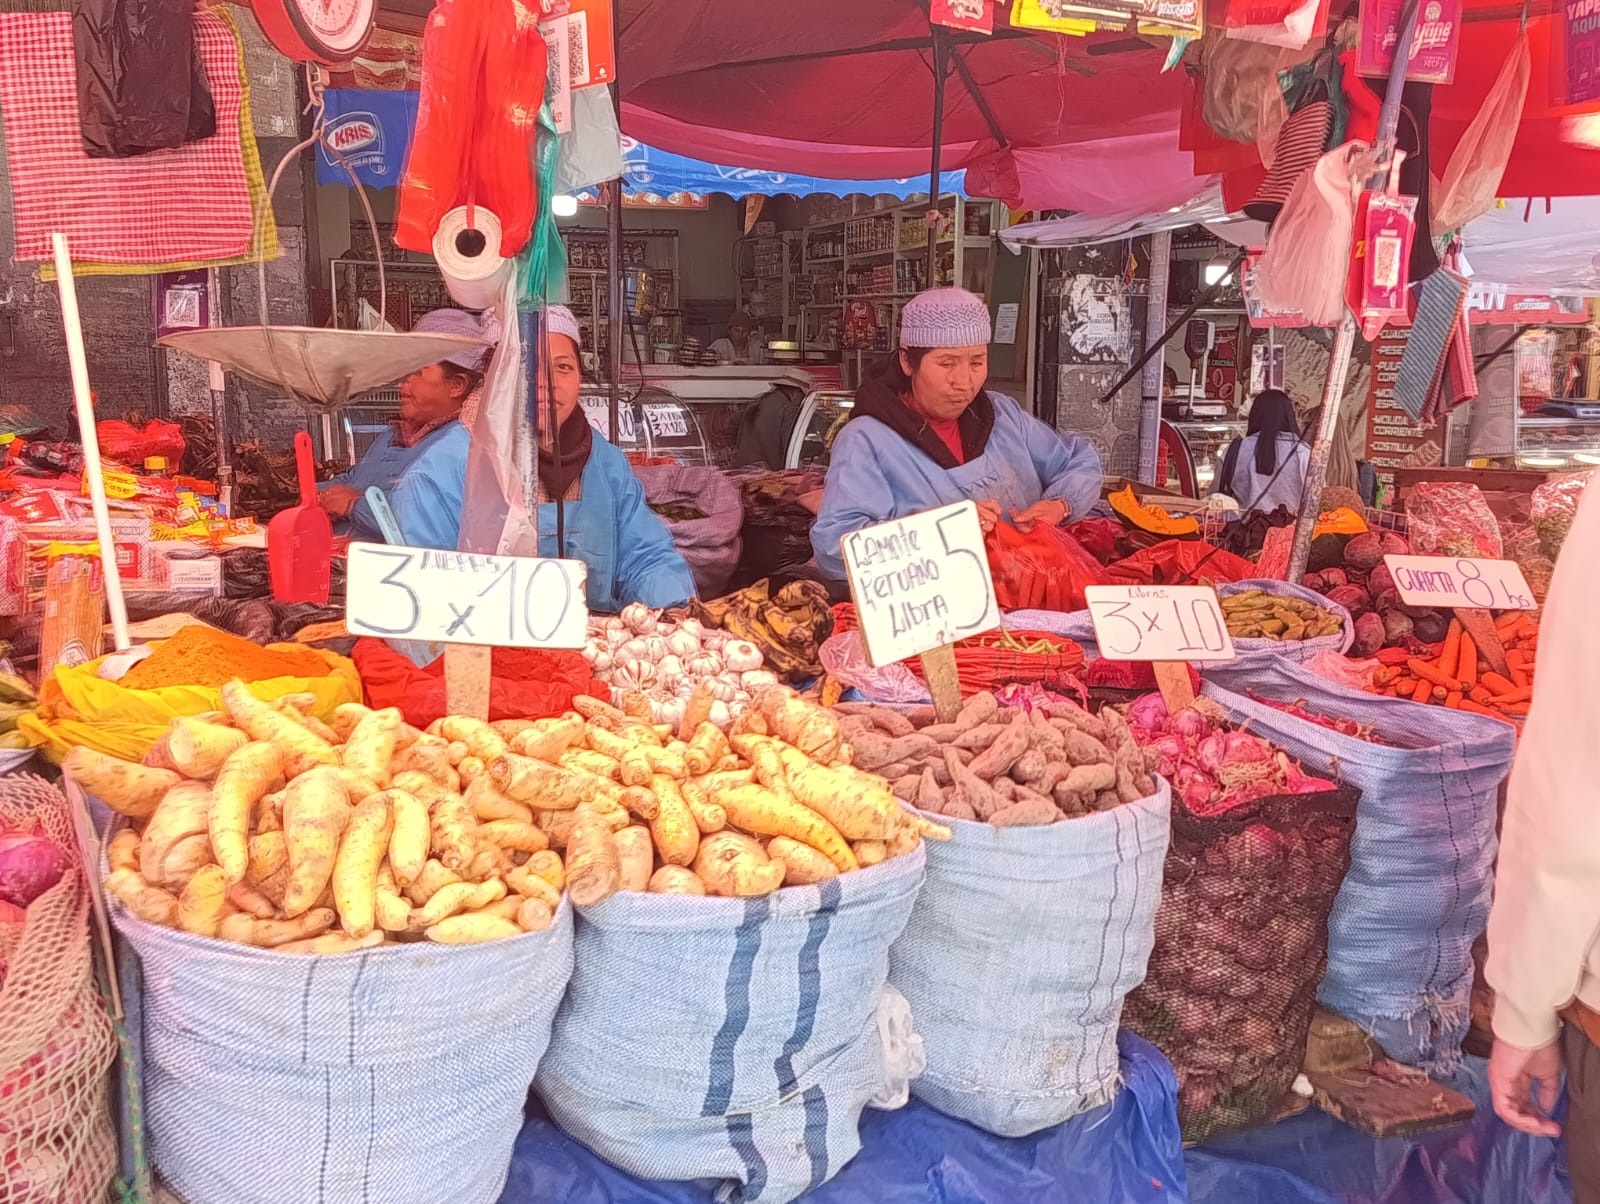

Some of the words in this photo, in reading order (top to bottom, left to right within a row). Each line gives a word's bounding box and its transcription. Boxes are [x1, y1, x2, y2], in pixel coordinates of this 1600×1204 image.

[334, 124, 372, 148] KRIS
[352, 548, 420, 634] 3
[476, 559, 572, 642] 10
[935, 507, 990, 631] 5
[1394, 566, 1458, 594] CUARTA
[1455, 559, 1495, 608] 8
[1090, 600, 1143, 655] 3
[1173, 598, 1225, 652] 10
